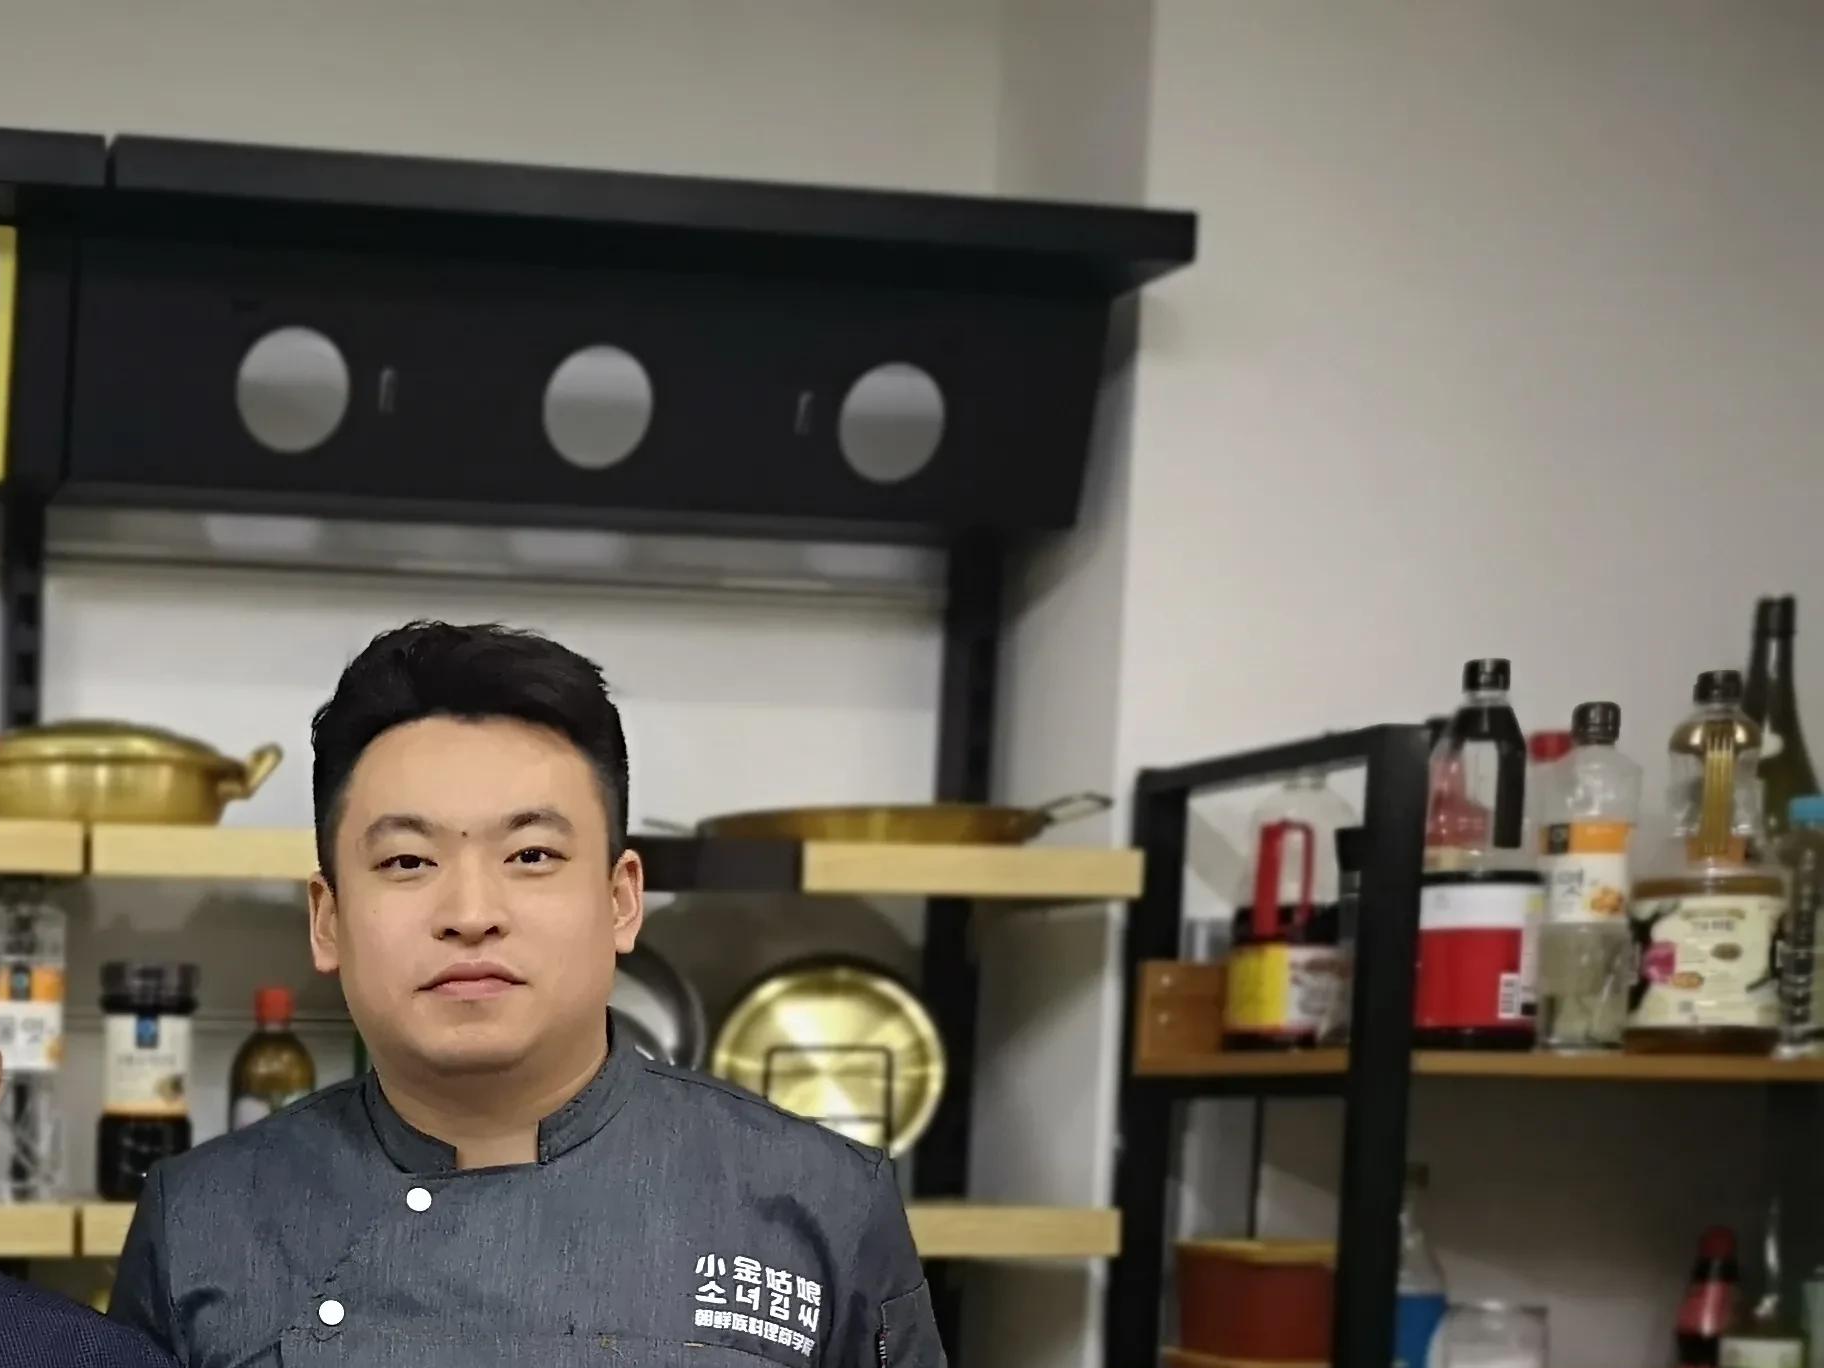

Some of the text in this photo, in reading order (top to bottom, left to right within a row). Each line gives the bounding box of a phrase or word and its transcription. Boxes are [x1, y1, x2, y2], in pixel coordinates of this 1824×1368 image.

[694, 1280, 820, 1333] 소녀김씨
[695, 1253, 822, 1307] 小金姑娘
[694, 1308, 816, 1357] 朝鲜族料理商学院
